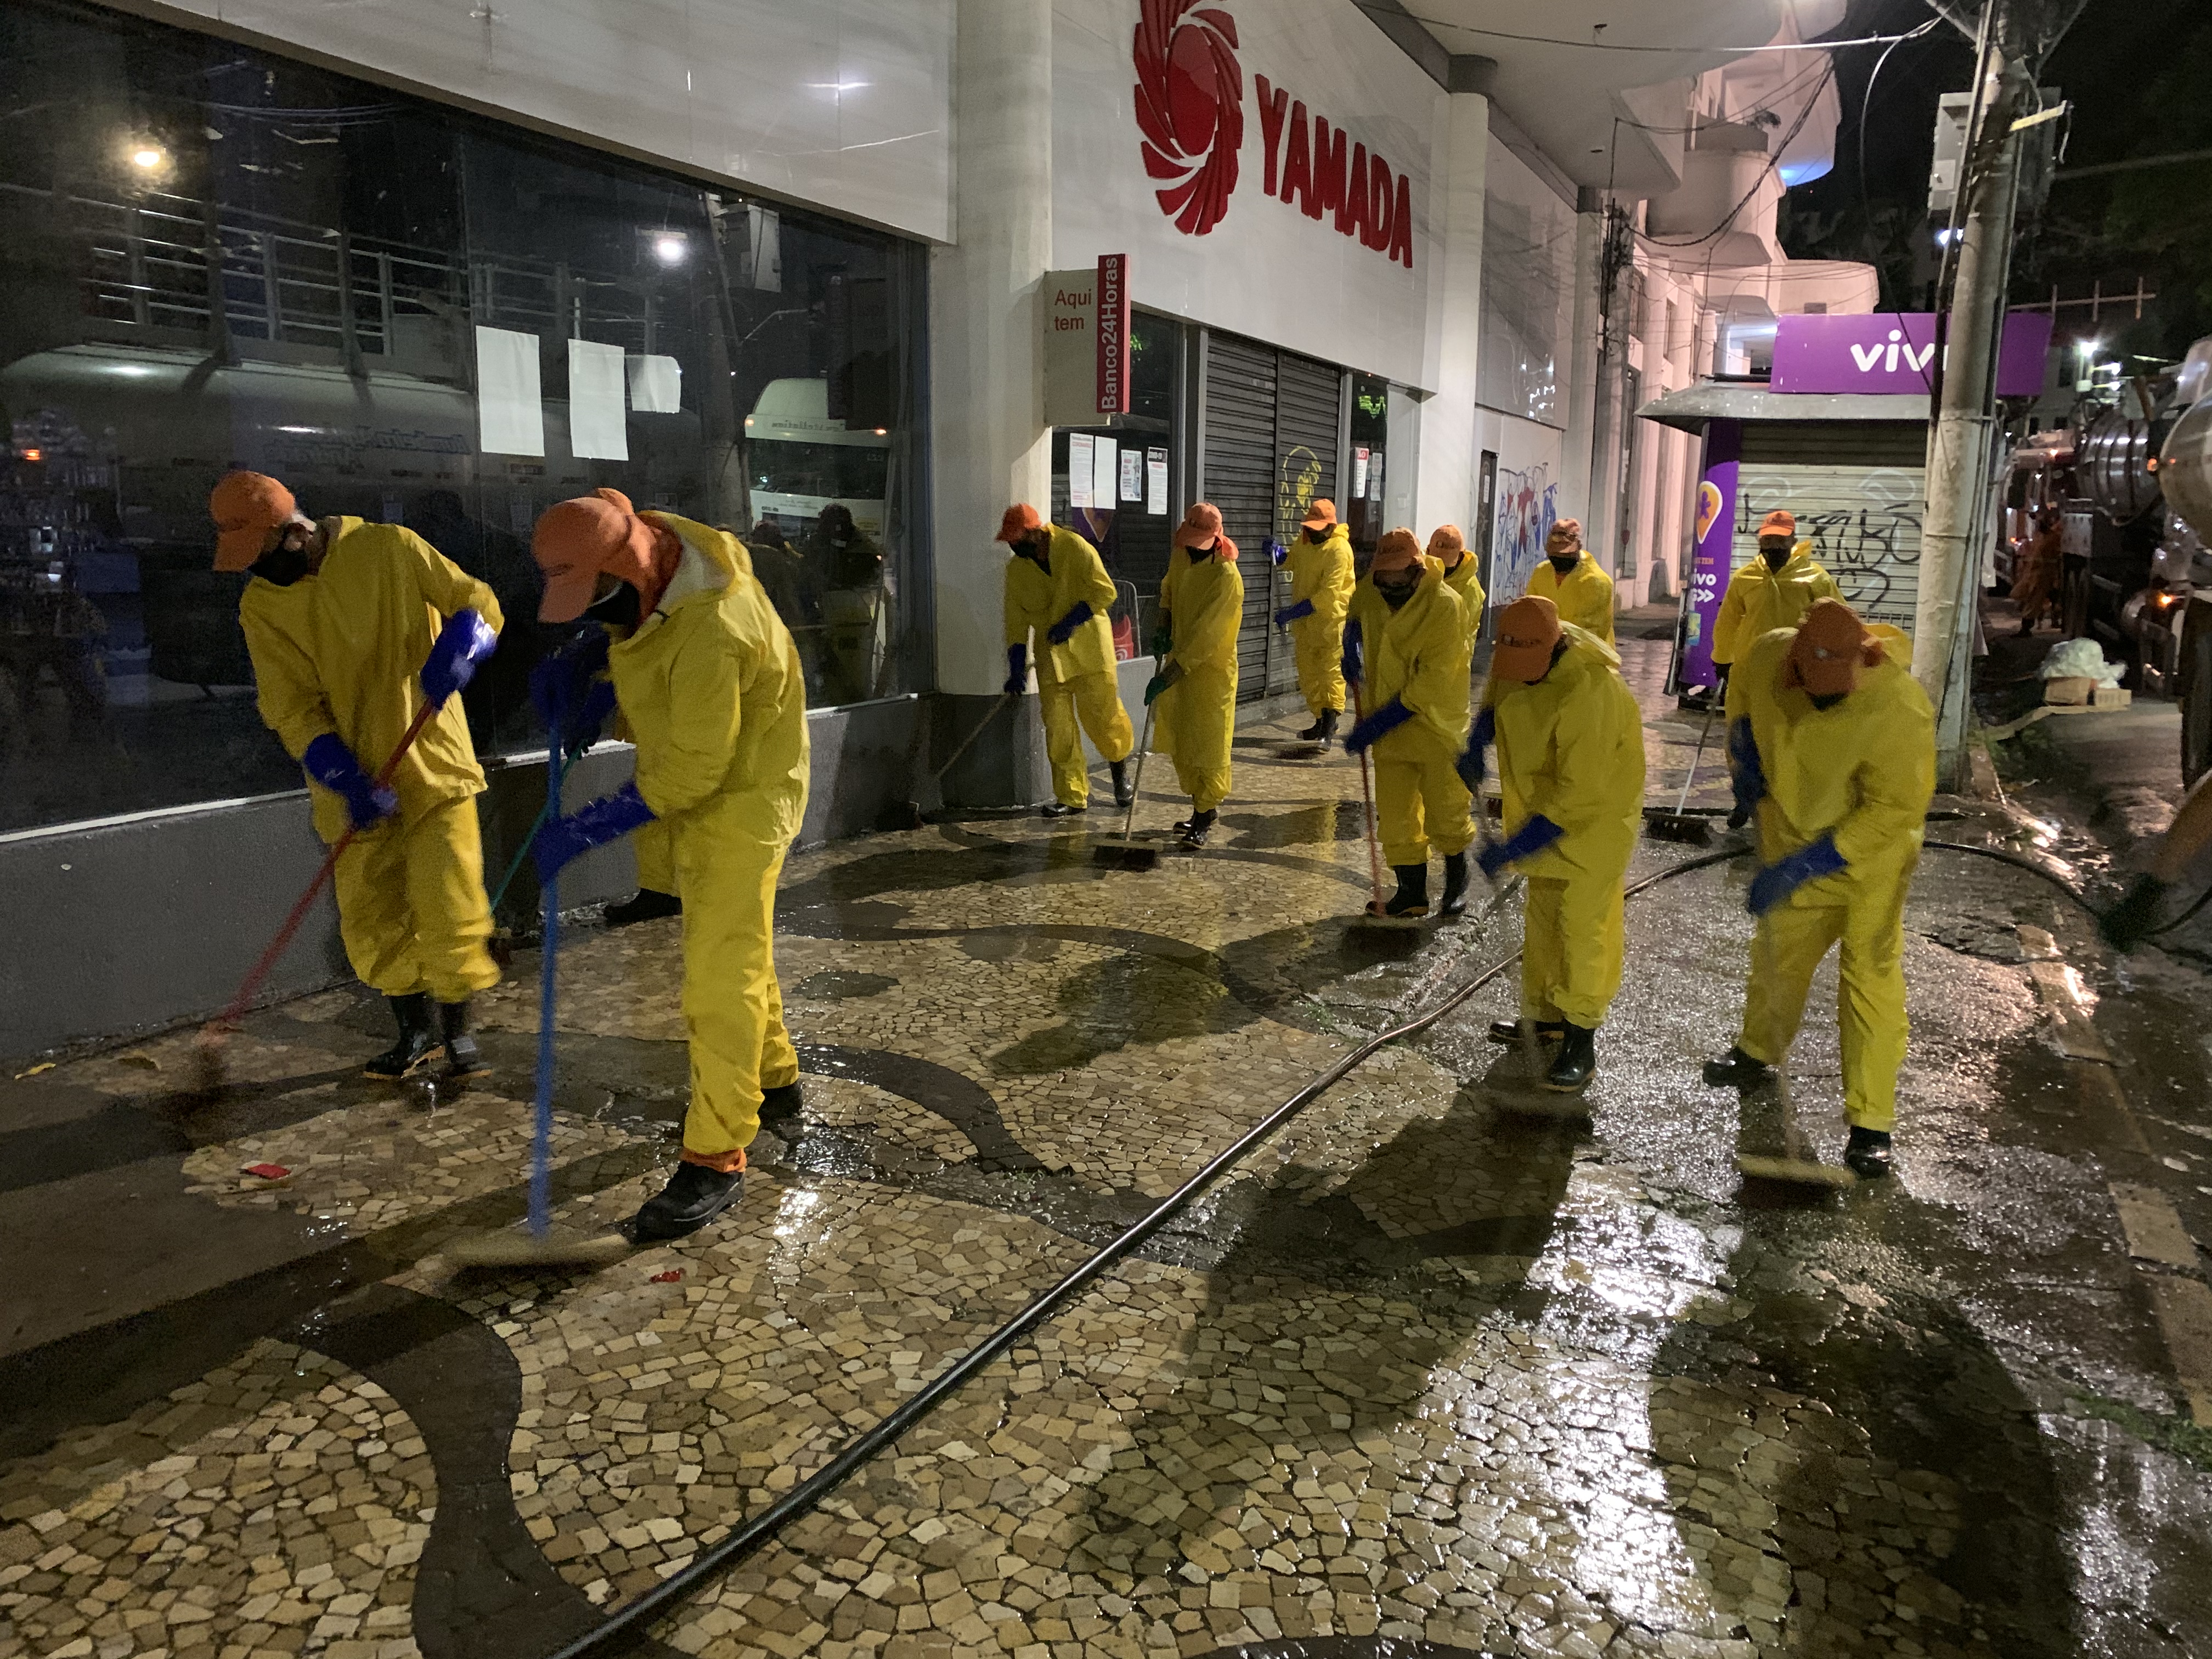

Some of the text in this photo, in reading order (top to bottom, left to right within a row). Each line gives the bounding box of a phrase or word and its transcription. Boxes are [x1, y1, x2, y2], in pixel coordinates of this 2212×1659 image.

[1255, 73, 1413, 269] YAMADA
[1054, 289, 1092, 310] Aqui
[1054, 315, 1085, 331] tem
[1101, 257, 1118, 410] Banco24Horas
[1849, 329, 1949, 373] viv
